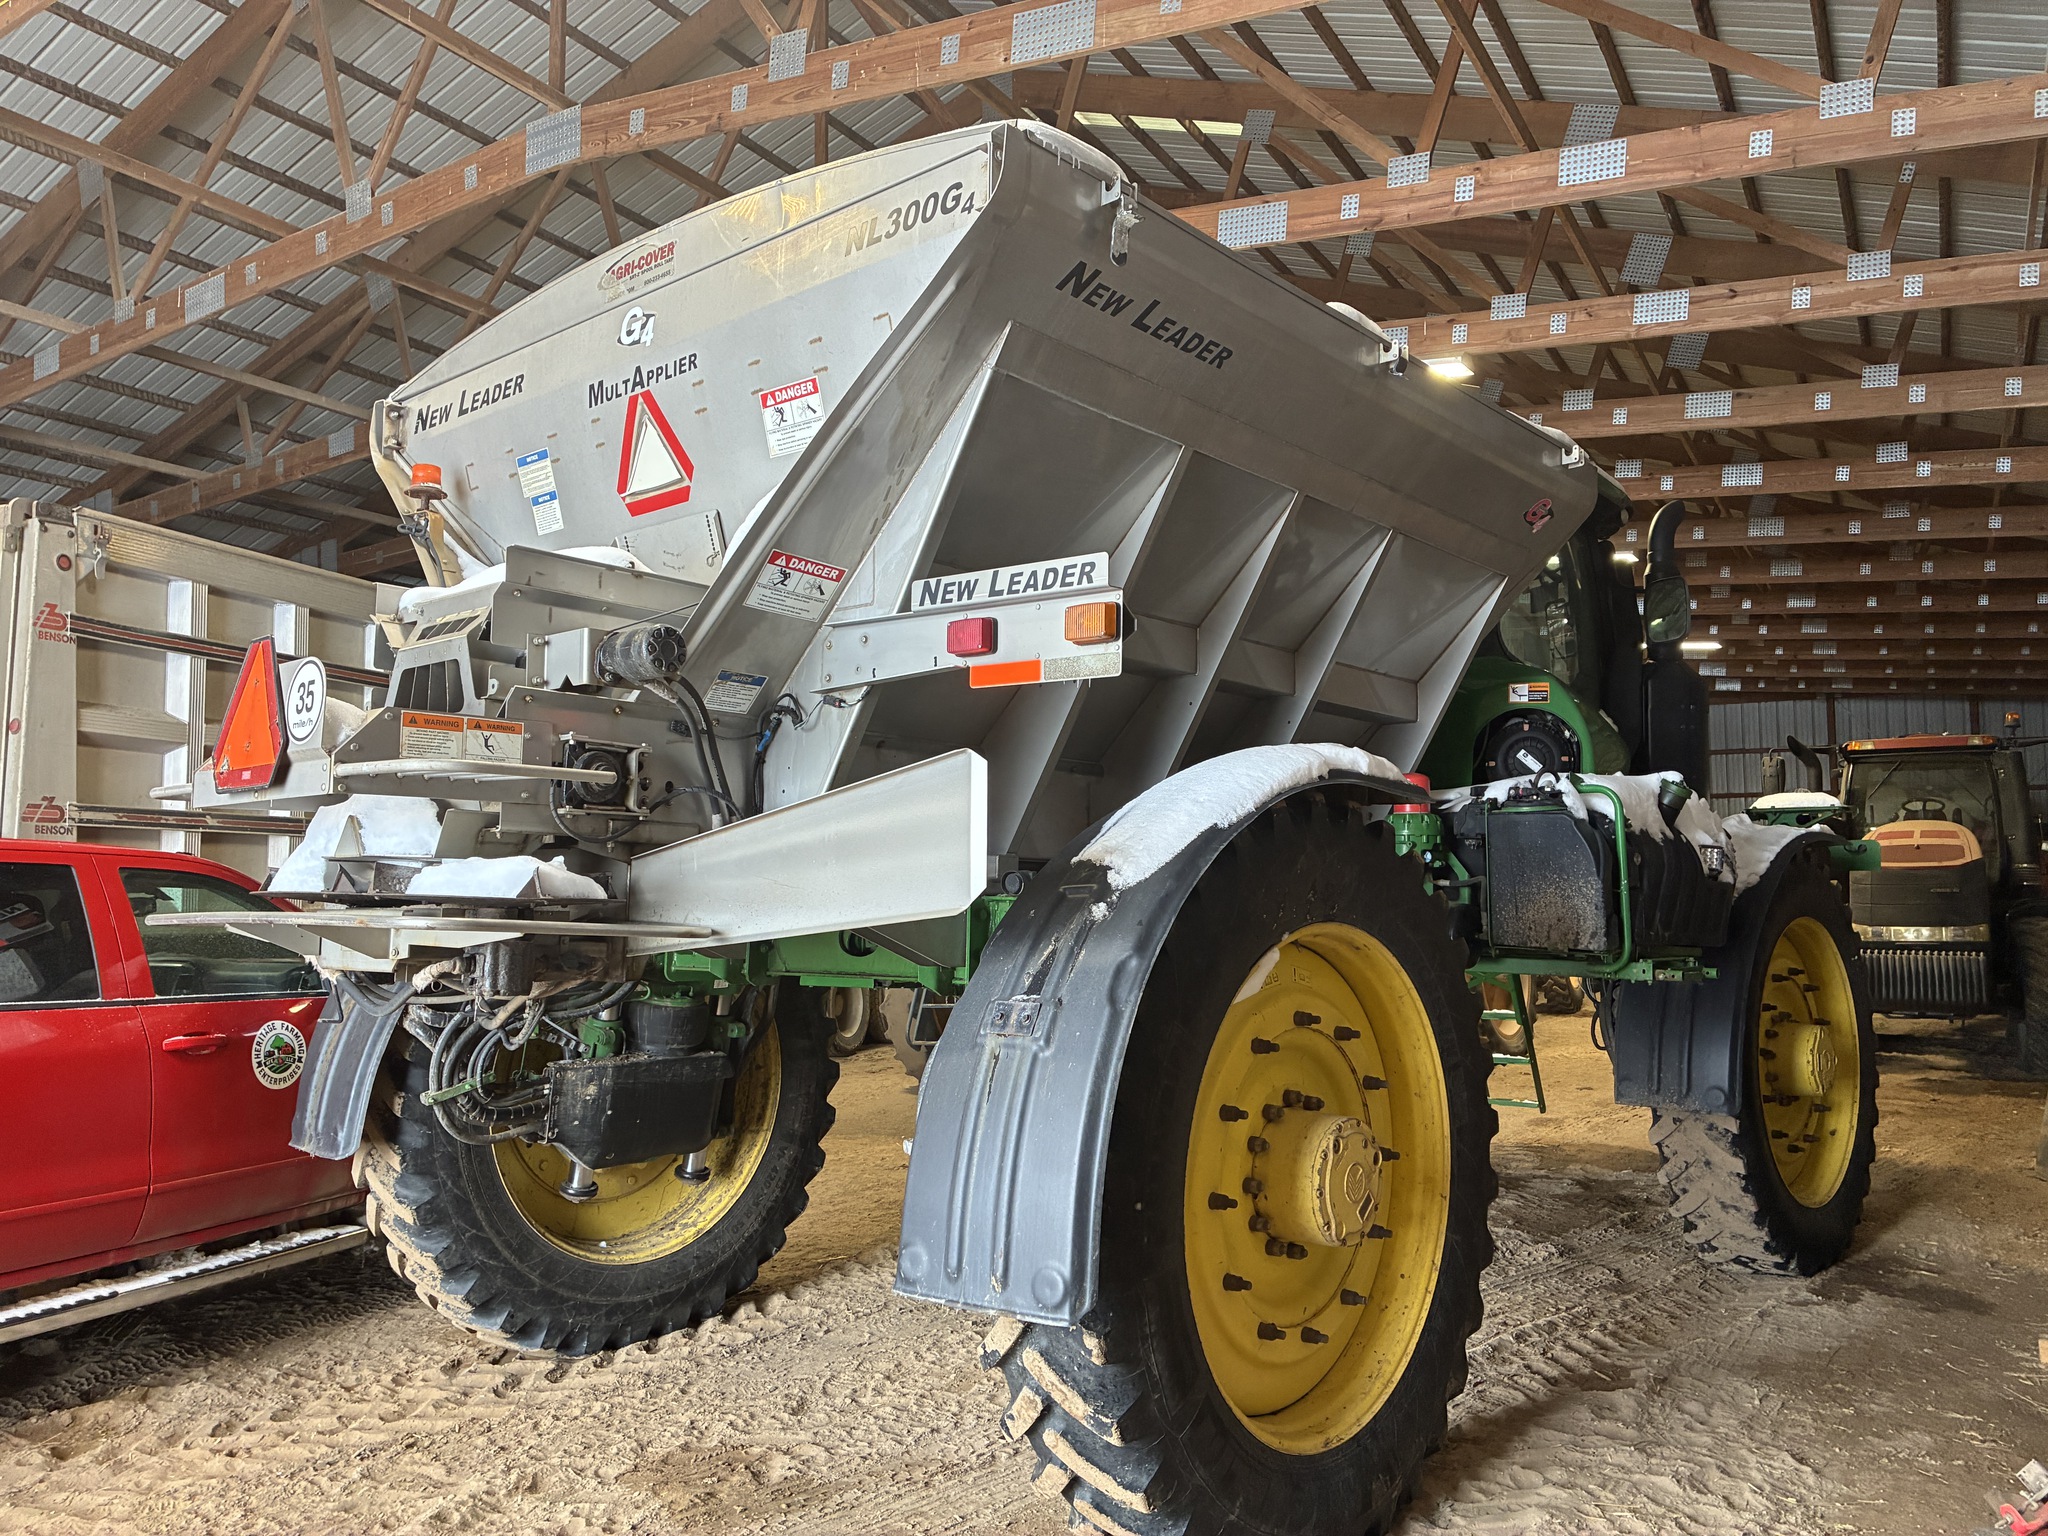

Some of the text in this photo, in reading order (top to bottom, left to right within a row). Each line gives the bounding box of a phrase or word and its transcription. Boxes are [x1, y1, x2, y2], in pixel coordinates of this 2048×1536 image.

[775, 381, 815, 403] DANGER
[788, 557, 840, 580] DANGER
[37, 630, 77, 645] BENSON
[295, 678, 316, 715] 35
[423, 718, 460, 728] WARNING
[486, 723, 516, 732] WARNING
[34, 825, 74, 836] BENSON
[254, 1022, 305, 1060] HERITAGE FARMING
[258, 1064, 301, 1086] ENTERPRISES
